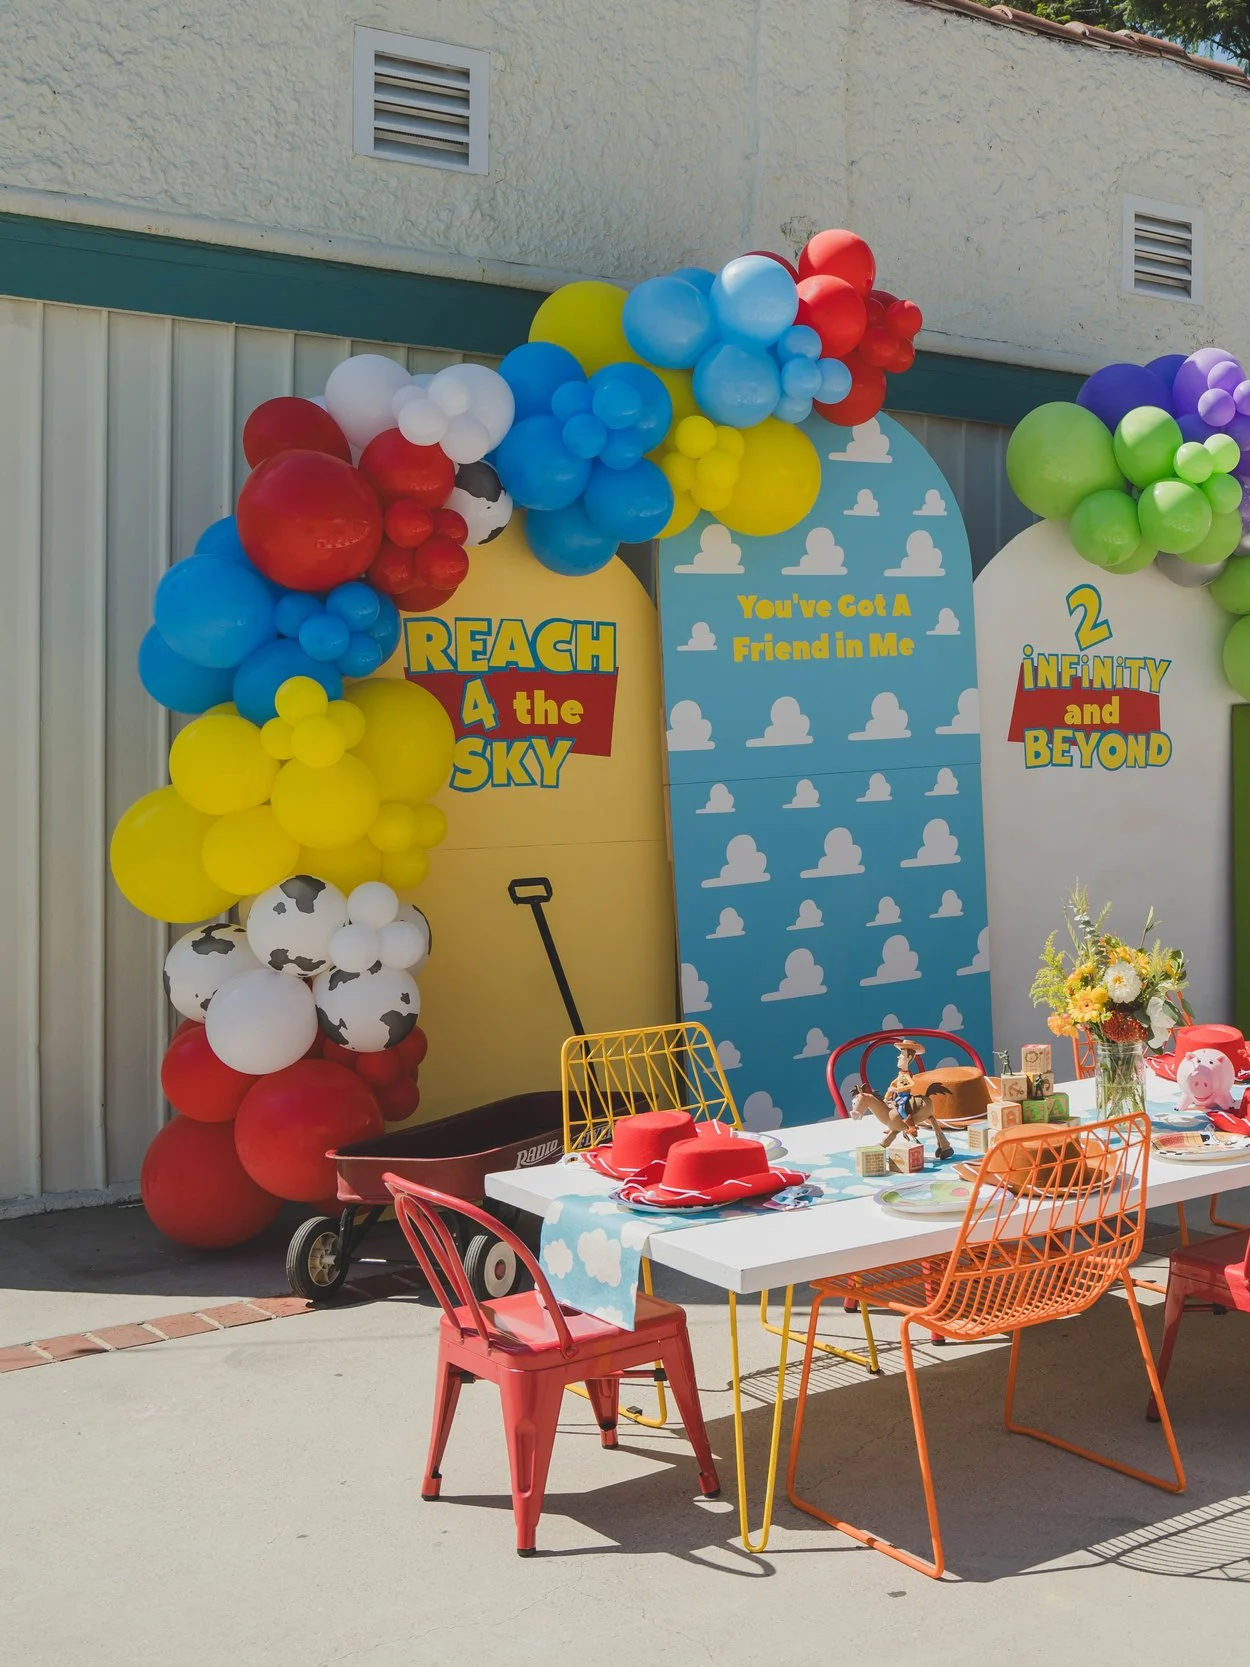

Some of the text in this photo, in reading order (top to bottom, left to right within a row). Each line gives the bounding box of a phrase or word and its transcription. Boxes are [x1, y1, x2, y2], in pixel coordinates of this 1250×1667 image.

[737, 593, 912, 619] You've Got A
[1065, 583, 1113, 652] 2
[403, 616, 617, 676] REACH
[733, 631, 915, 662] Friend in Me
[459, 674, 584, 732] 4 the
[1064, 695, 1120, 725] and
[449, 734, 576, 792] SKY
[1024, 727, 1172, 771] BEYOND
[515, 1139, 559, 1170] RADIO
